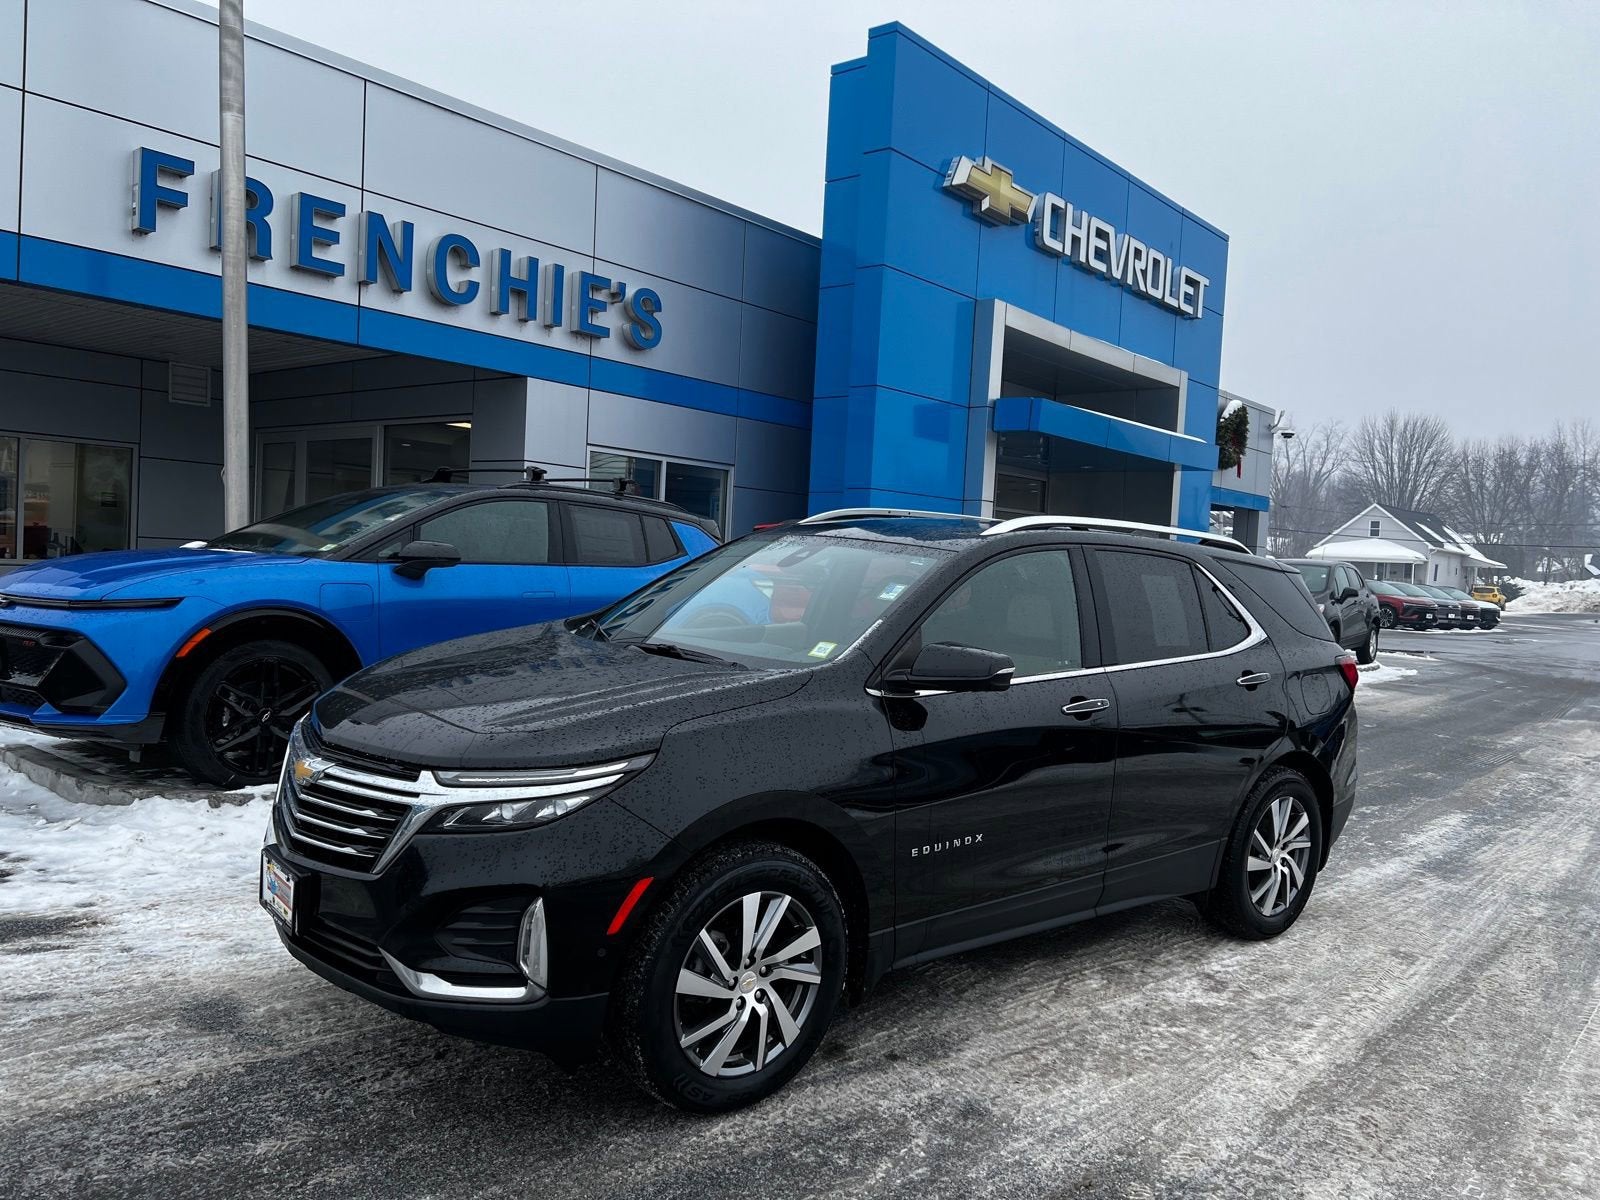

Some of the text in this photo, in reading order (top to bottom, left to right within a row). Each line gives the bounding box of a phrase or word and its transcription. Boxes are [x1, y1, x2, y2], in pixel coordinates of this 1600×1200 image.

[131, 147, 663, 351] FRENCHIE'S
[1036, 192, 1210, 319] CHEVROLET
[911, 833, 983, 857] EQUINOX
